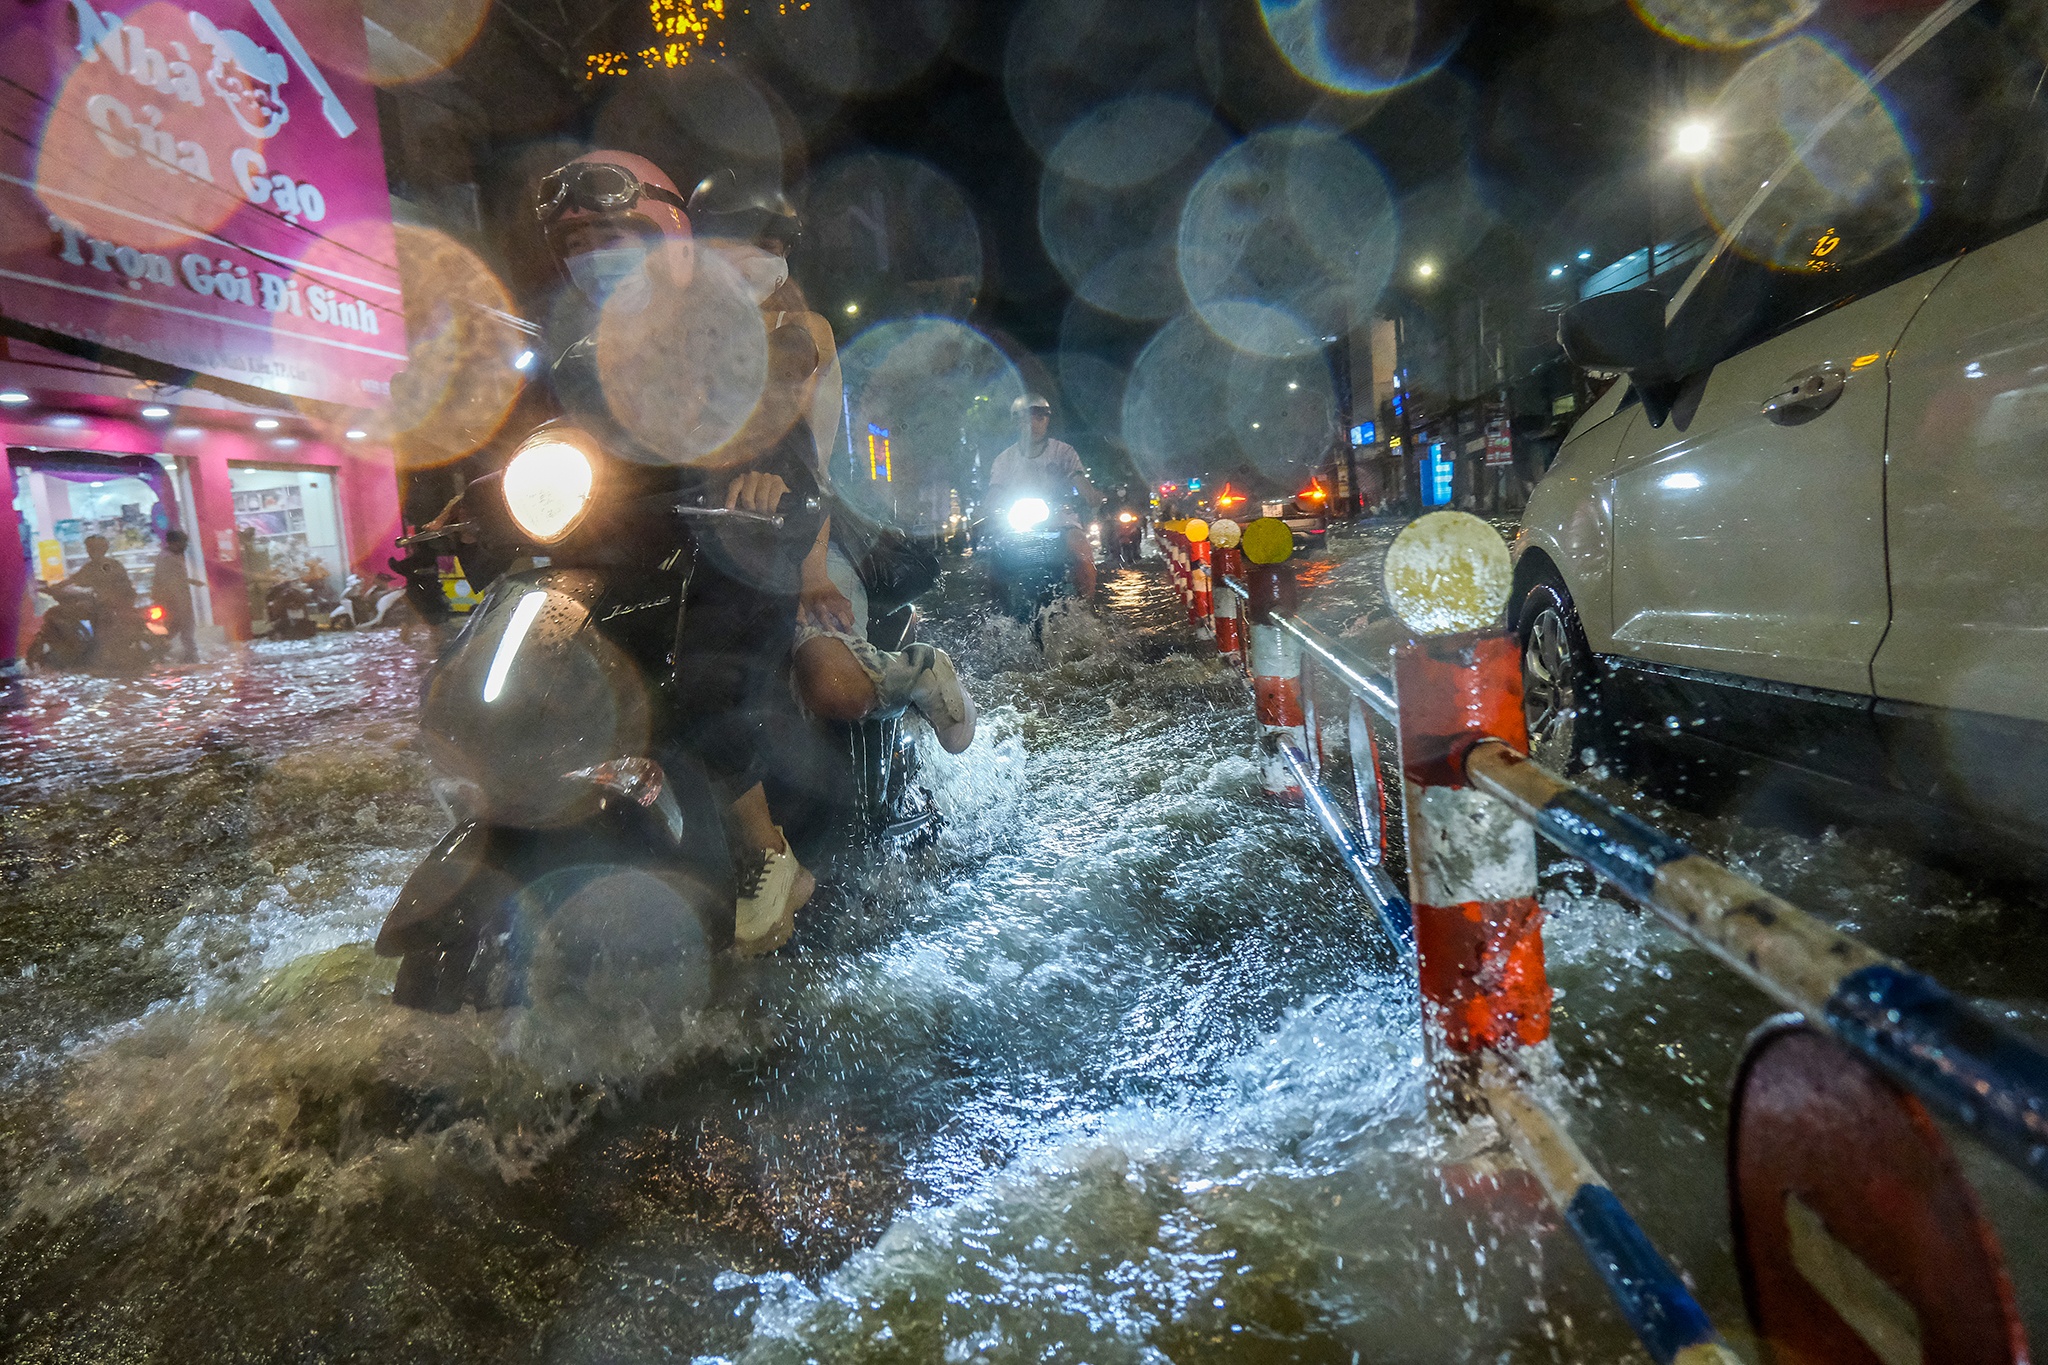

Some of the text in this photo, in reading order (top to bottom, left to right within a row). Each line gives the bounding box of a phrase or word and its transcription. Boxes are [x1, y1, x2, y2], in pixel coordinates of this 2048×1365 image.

[70, 0, 205, 107] Nhà
[86, 93, 326, 228] Của Gạo
[48, 213, 175, 290] Trọn
[306, 285, 380, 335] Sinh
